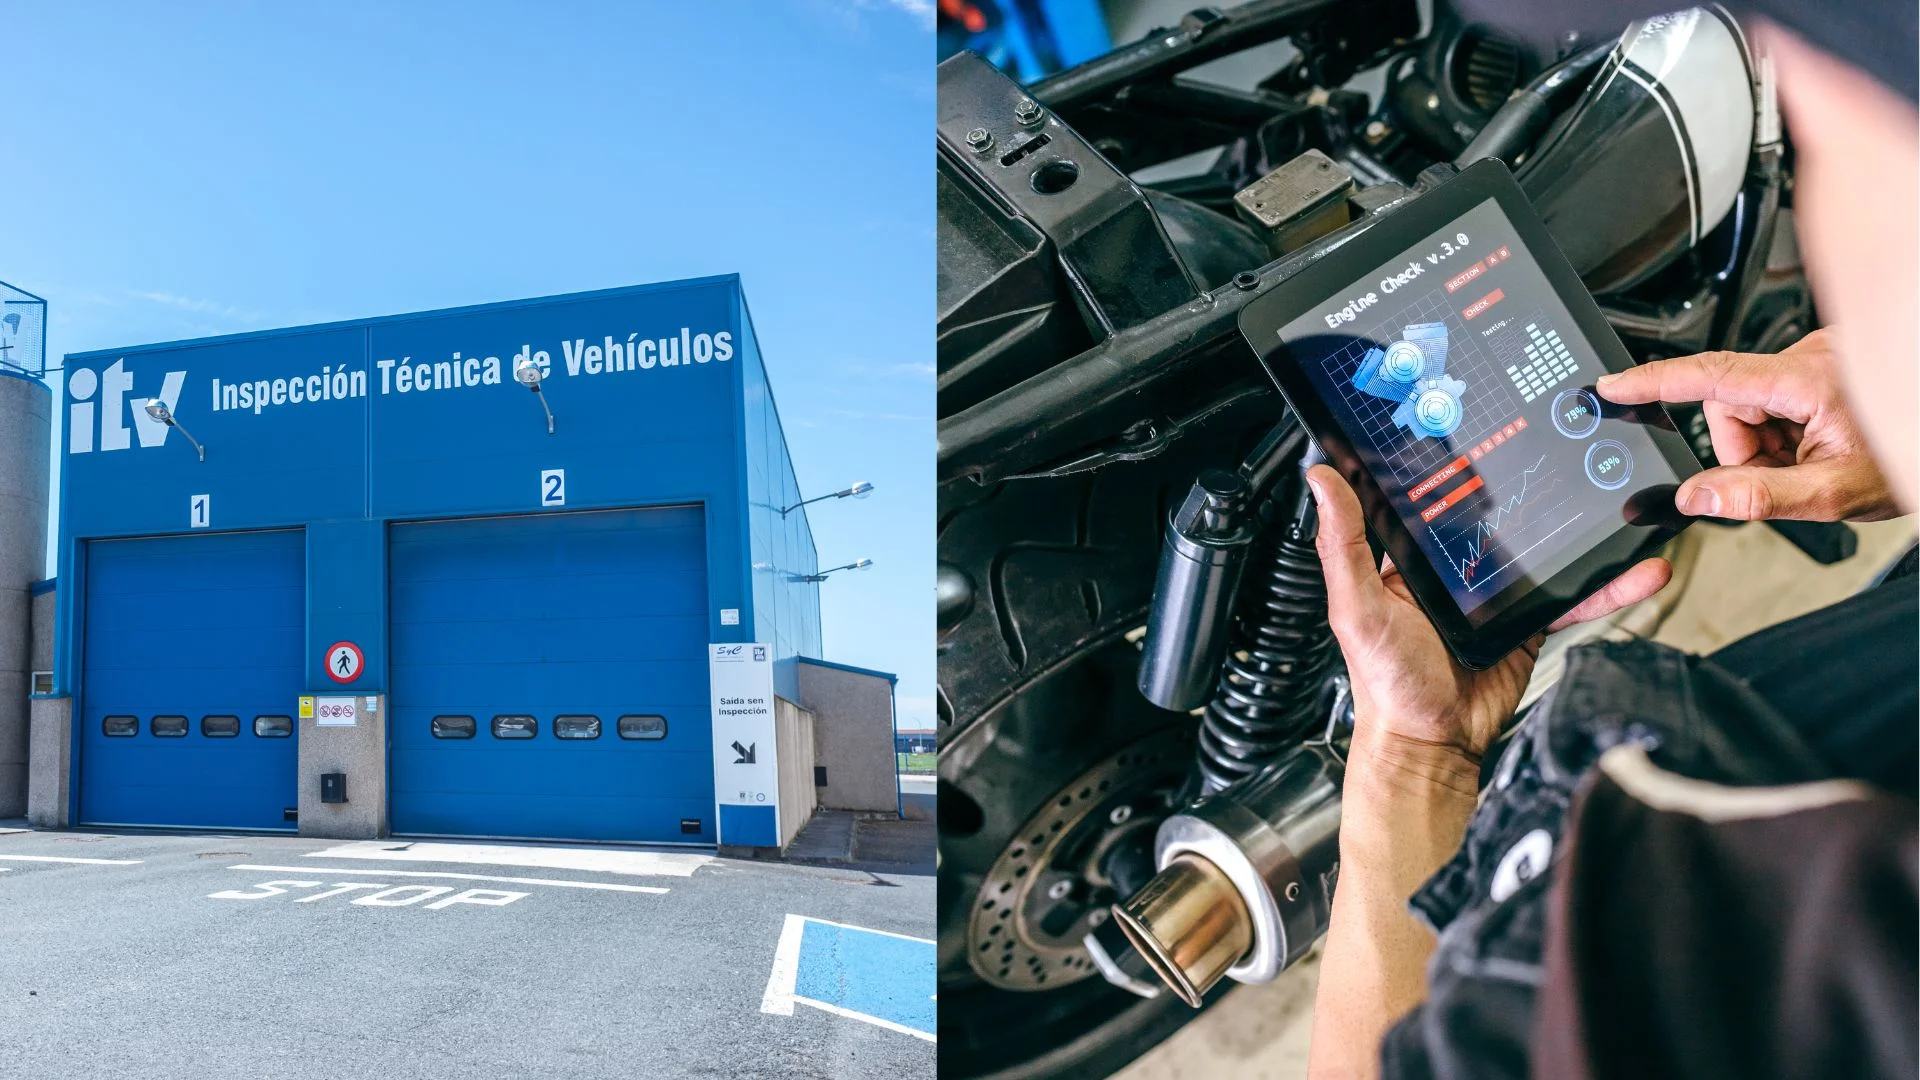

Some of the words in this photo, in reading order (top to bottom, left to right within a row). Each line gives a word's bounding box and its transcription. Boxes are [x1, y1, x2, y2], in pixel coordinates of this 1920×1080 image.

[1325, 292, 1378, 329] Engine
[1380, 262, 1425, 294] Check
[1426, 233, 1470, 265] v.3.0
[1448, 267, 1480, 290] SECTION
[1466, 300, 1489, 317] CHECK
[212, 363, 366, 414] Inspección
[377, 352, 501, 395] Técnica
[562, 328, 734, 376] Vehículos
[1565, 405, 1587, 423] 79%
[1598, 456, 1620, 474] 53%
[545, 475, 563, 501] 2
[1411, 466, 1456, 498] CONNECTING
[194, 499, 204, 523] 1
[1424, 501, 1448, 519] POWER
[718, 706, 767, 716] Inspección
[207, 880, 533, 909] STOP
